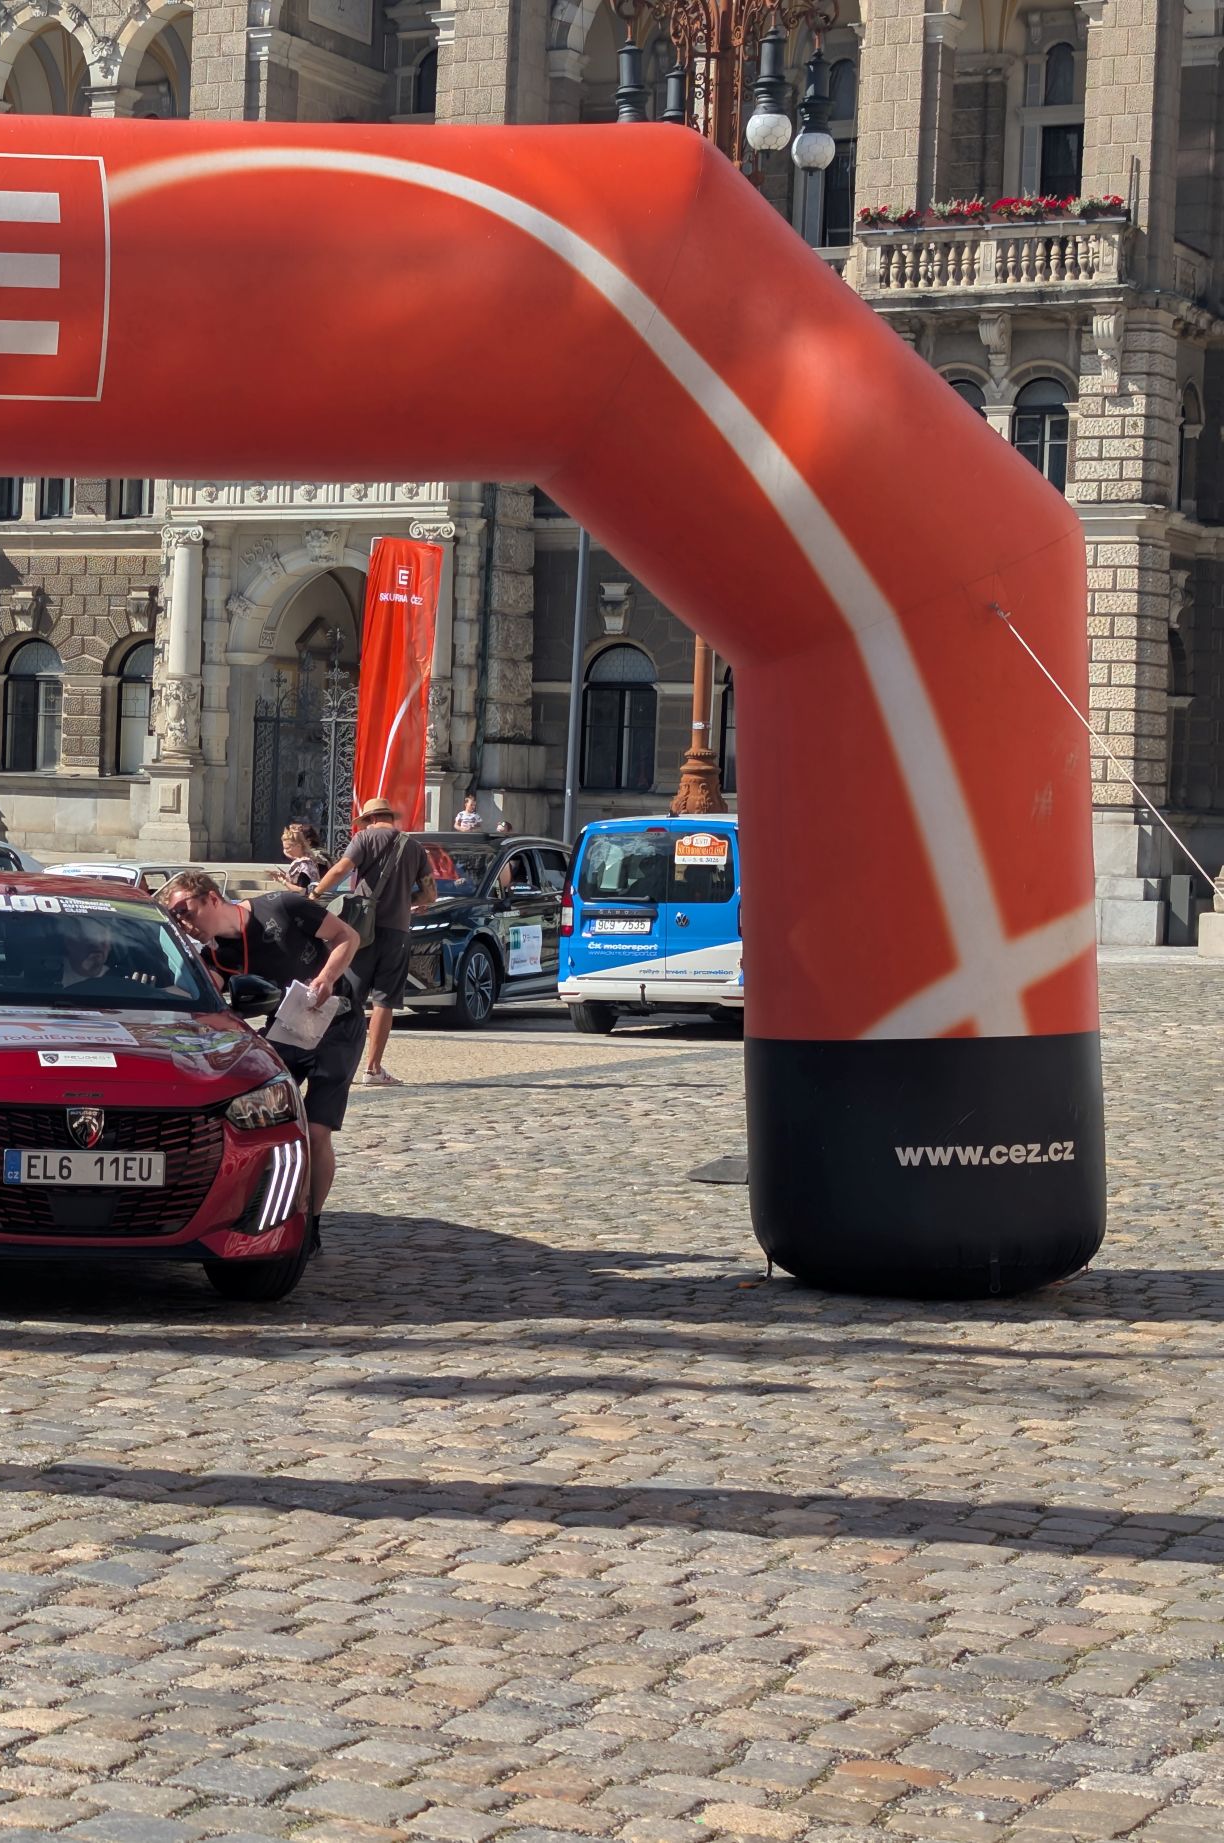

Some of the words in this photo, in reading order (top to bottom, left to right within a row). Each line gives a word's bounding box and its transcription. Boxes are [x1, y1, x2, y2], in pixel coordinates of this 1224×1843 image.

[410, 594, 424, 606] ČEZ
[622, 920, 646, 930] 7535
[604, 942, 659, 952] motorsport
[2, 1033, 135, 1044] TotalEnergies
[894, 1140, 1075, 1167] www.cez.cz
[7, 1171, 19, 1180] CZ
[27, 1155, 72, 1181] EL6
[94, 1156, 153, 1182] 11EU
